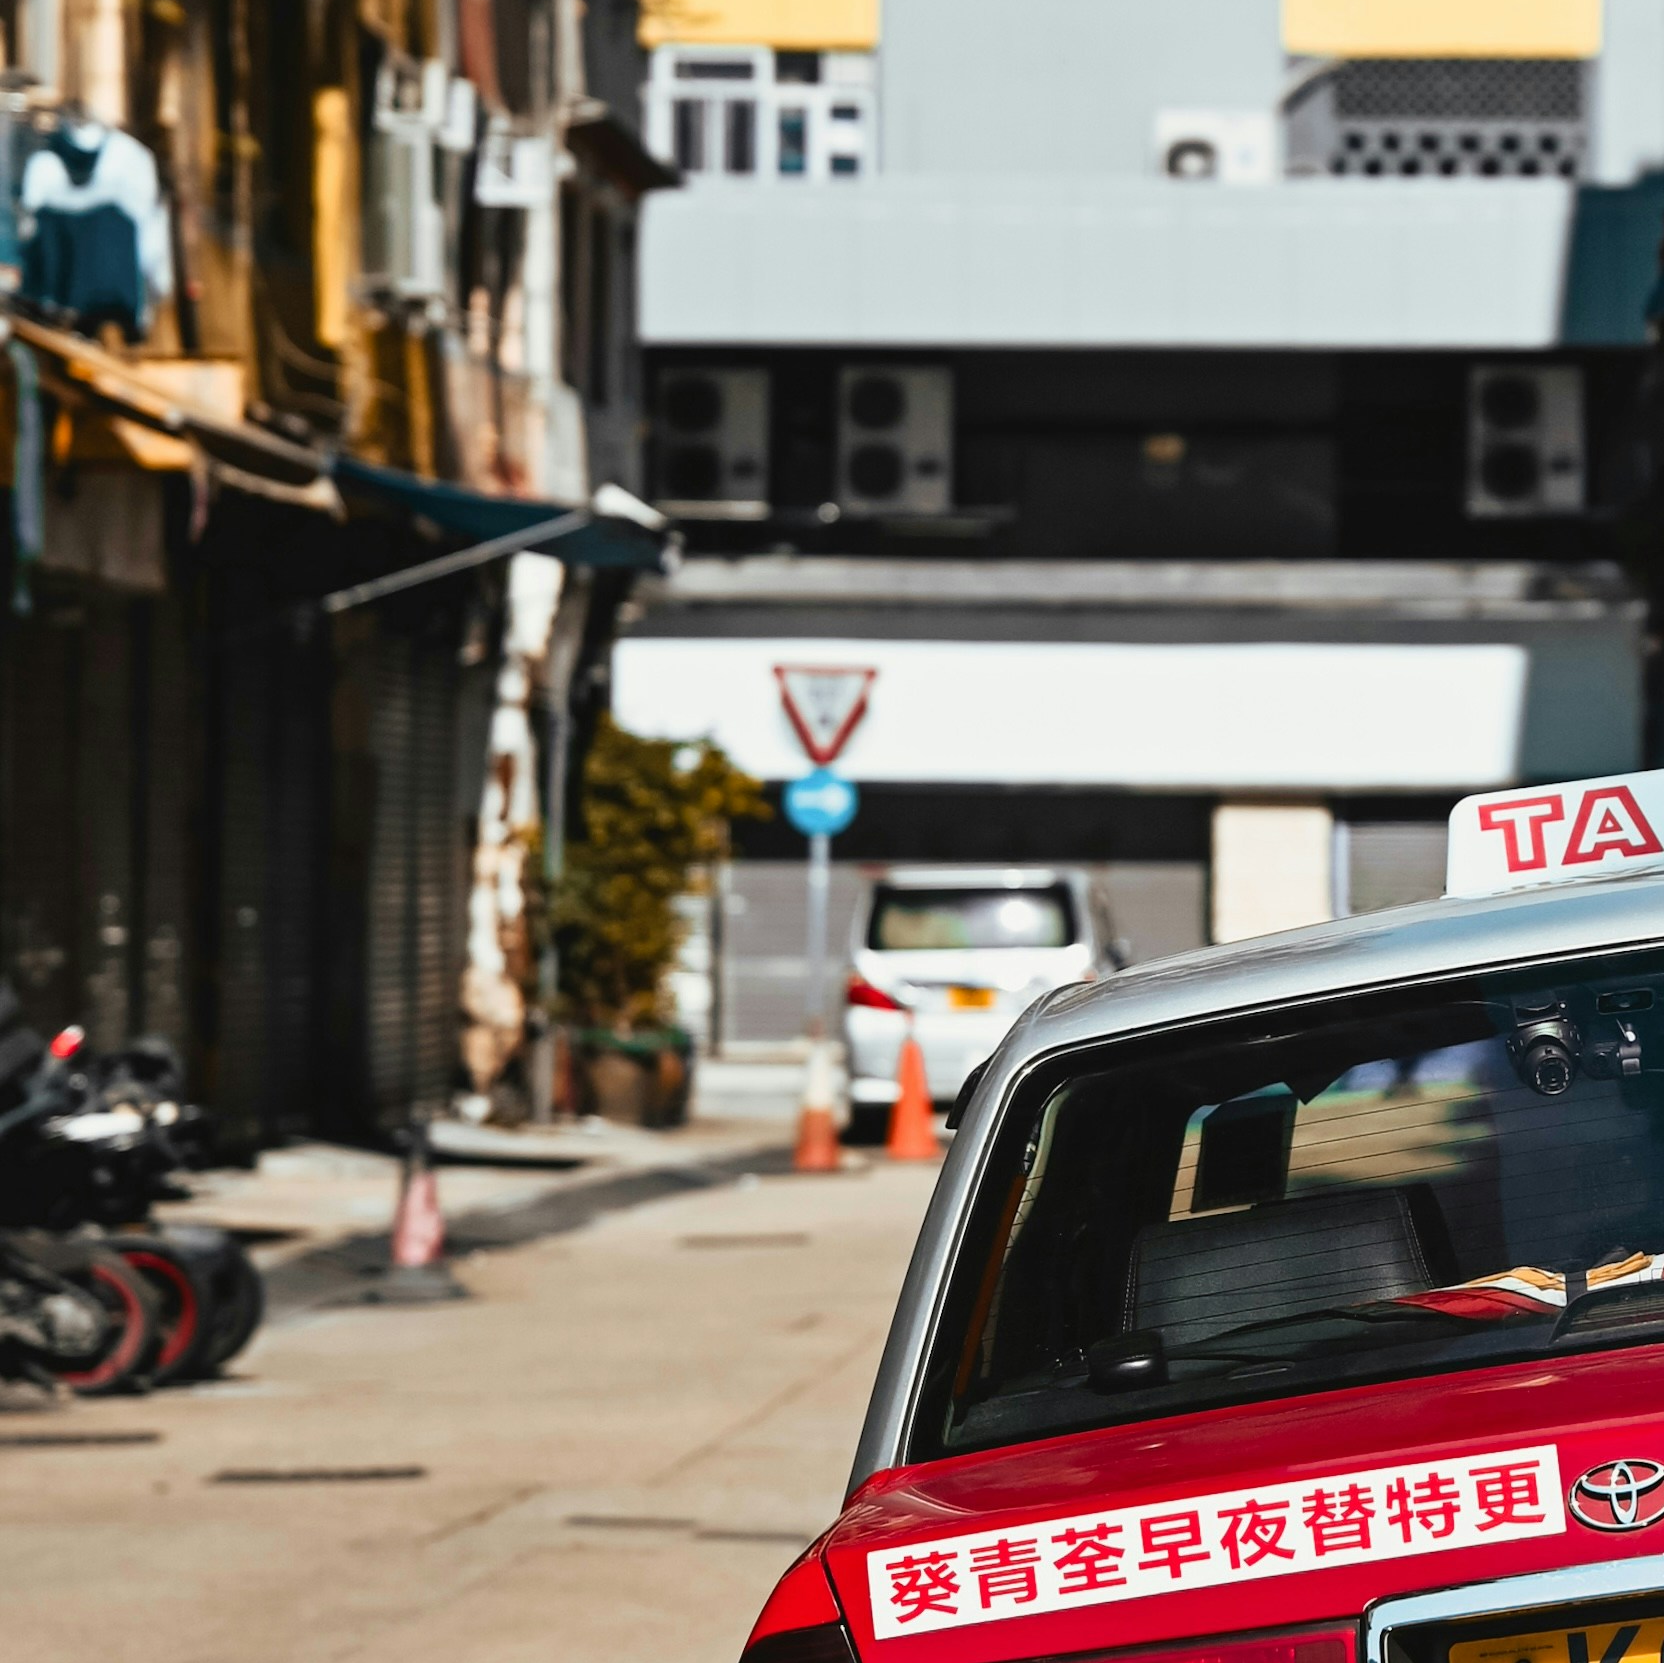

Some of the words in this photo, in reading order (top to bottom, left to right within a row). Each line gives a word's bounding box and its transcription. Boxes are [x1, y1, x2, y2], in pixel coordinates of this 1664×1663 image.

[886, 1458, 1547, 1623] 葵青荃早夜替特更
